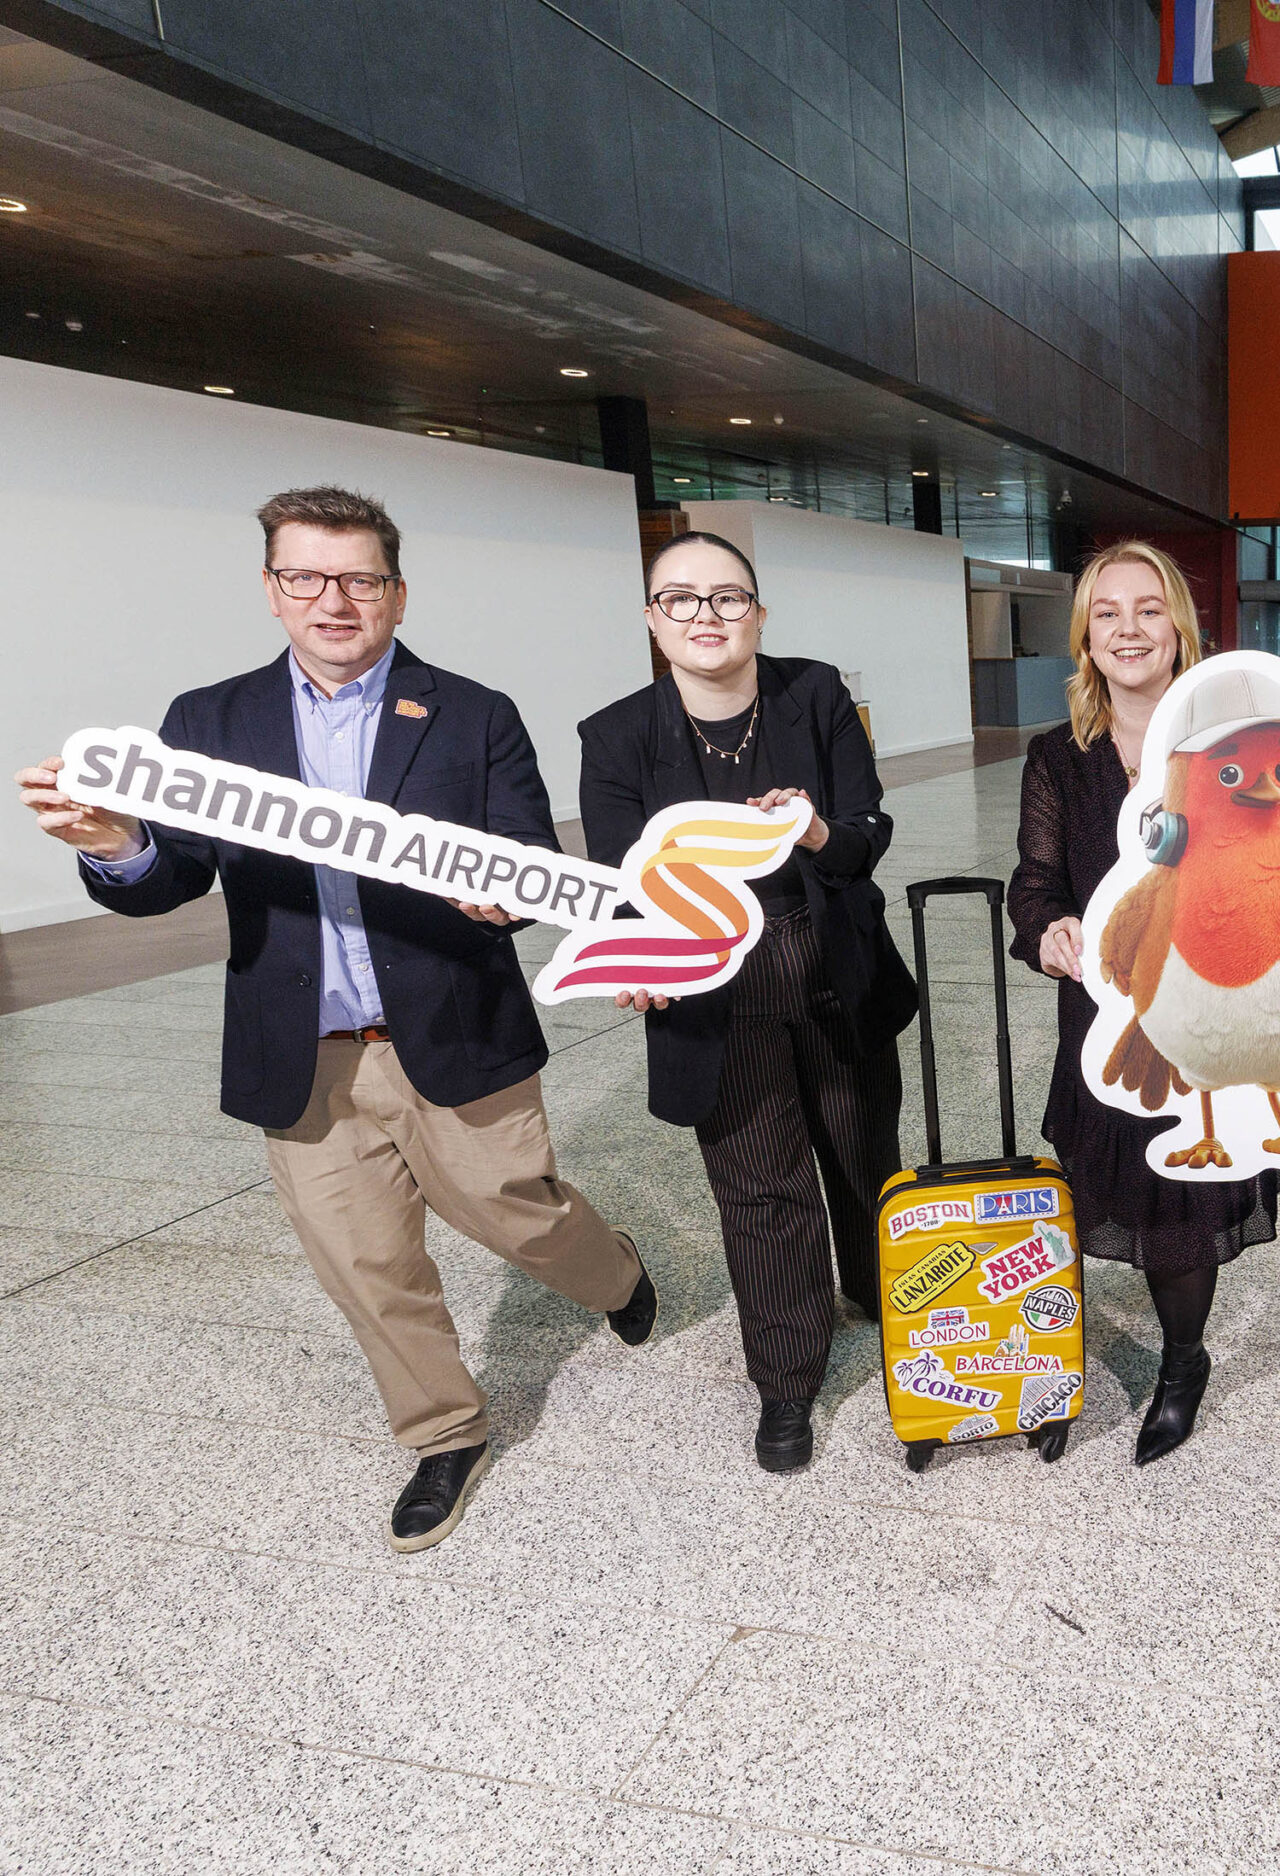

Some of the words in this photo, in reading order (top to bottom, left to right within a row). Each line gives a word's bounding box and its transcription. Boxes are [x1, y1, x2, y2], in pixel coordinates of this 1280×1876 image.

[77, 743, 389, 863] shannon
[391, 832, 619, 922] AIRPORT
[979, 1189, 1054, 1217] PARIS
[891, 1203, 970, 1235] BOSTON
[986, 1236, 1045, 1279] NEW
[894, 1247, 969, 1308] LANZAROTE
[983, 1253, 1056, 1299] YORK
[1025, 1296, 1077, 1320] NAPLES
[911, 1324, 986, 1346] LONDON
[956, 1356, 1060, 1371] BARCELONA
[912, 1377, 998, 1408] CORFU
[1018, 1374, 1082, 1430] CHICAGO
[952, 1421, 994, 1442] PORTO
